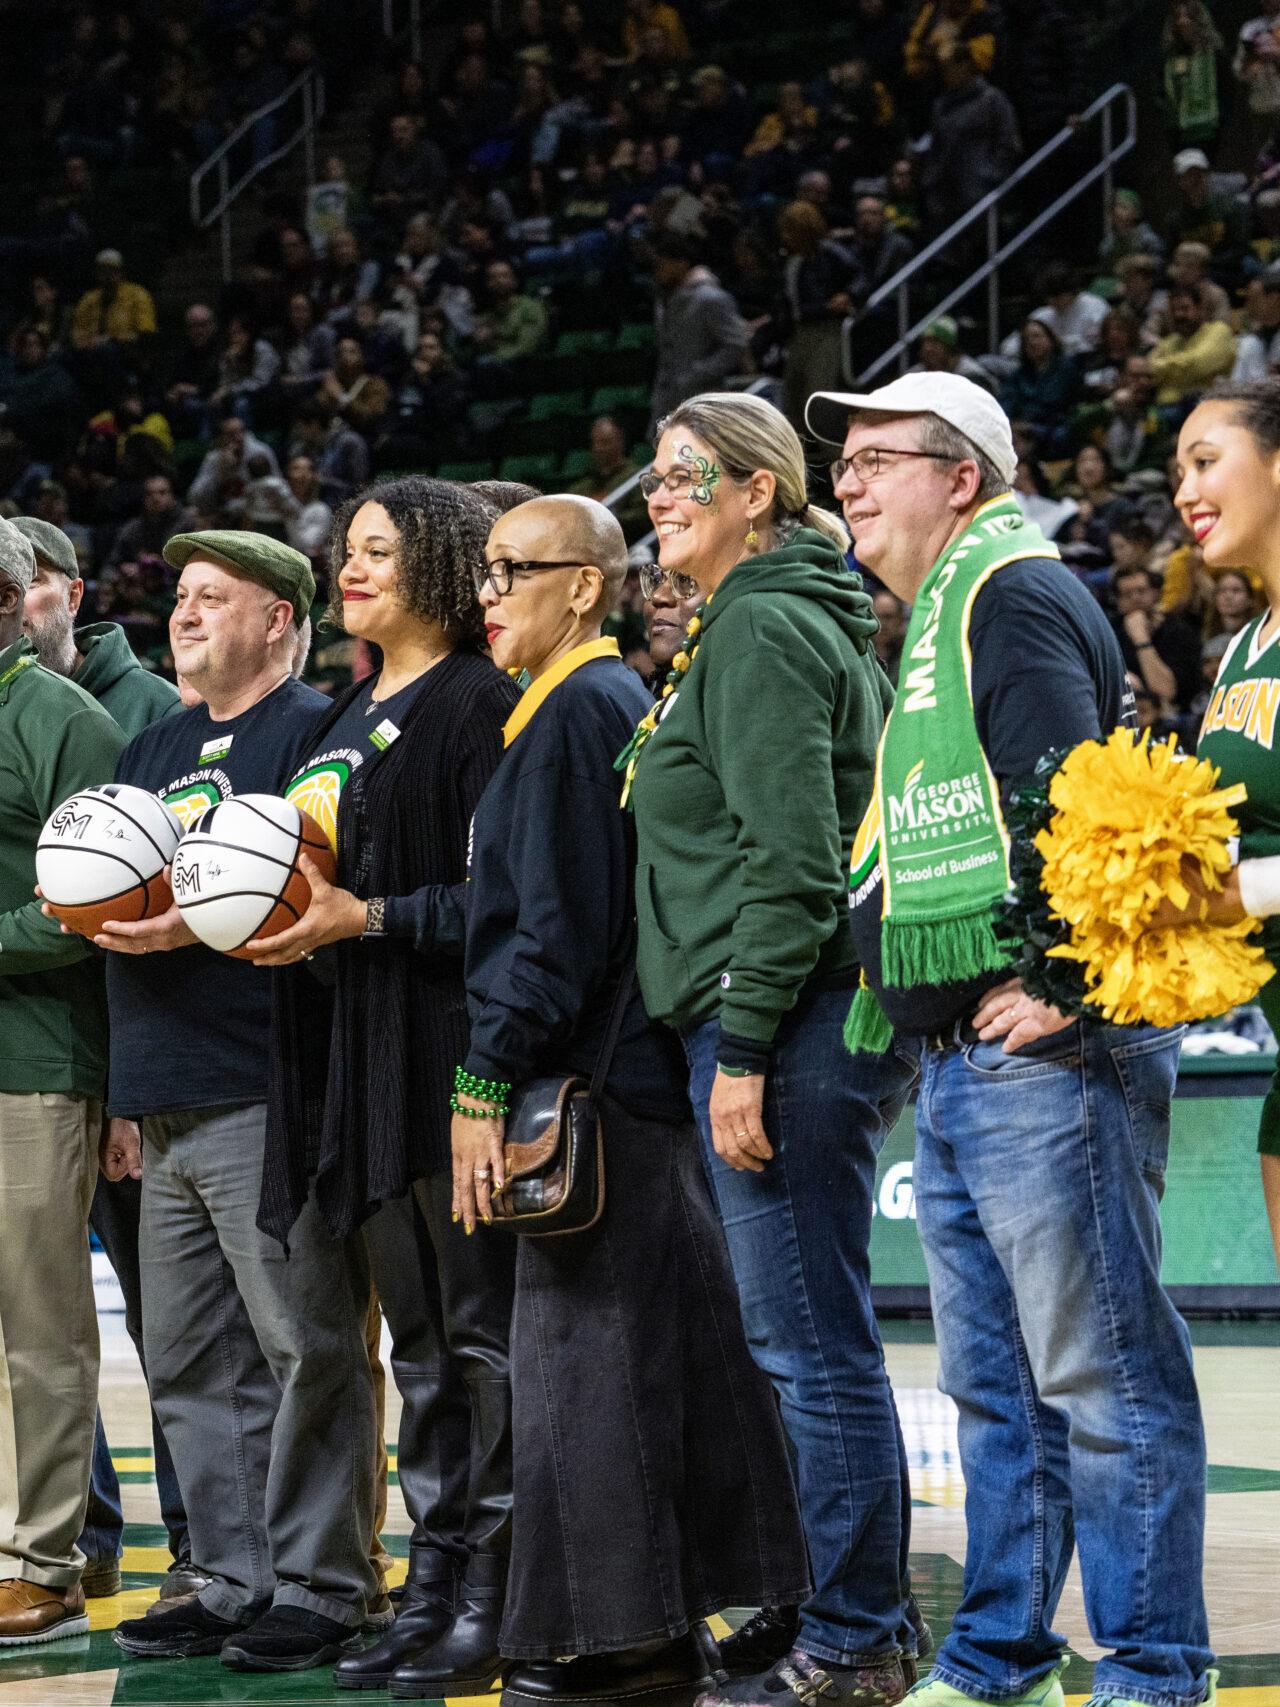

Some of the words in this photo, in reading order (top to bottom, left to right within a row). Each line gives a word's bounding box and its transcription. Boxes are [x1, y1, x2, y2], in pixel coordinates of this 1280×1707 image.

[168, 769, 212, 792] MASON
[917, 772, 980, 801] GEORGE
[888, 784, 985, 832] MASON
[891, 813, 989, 845] UNIVERSITY
[896, 864, 933, 884] School
[934, 861, 947, 877] of
[948, 850, 998, 874] Business
